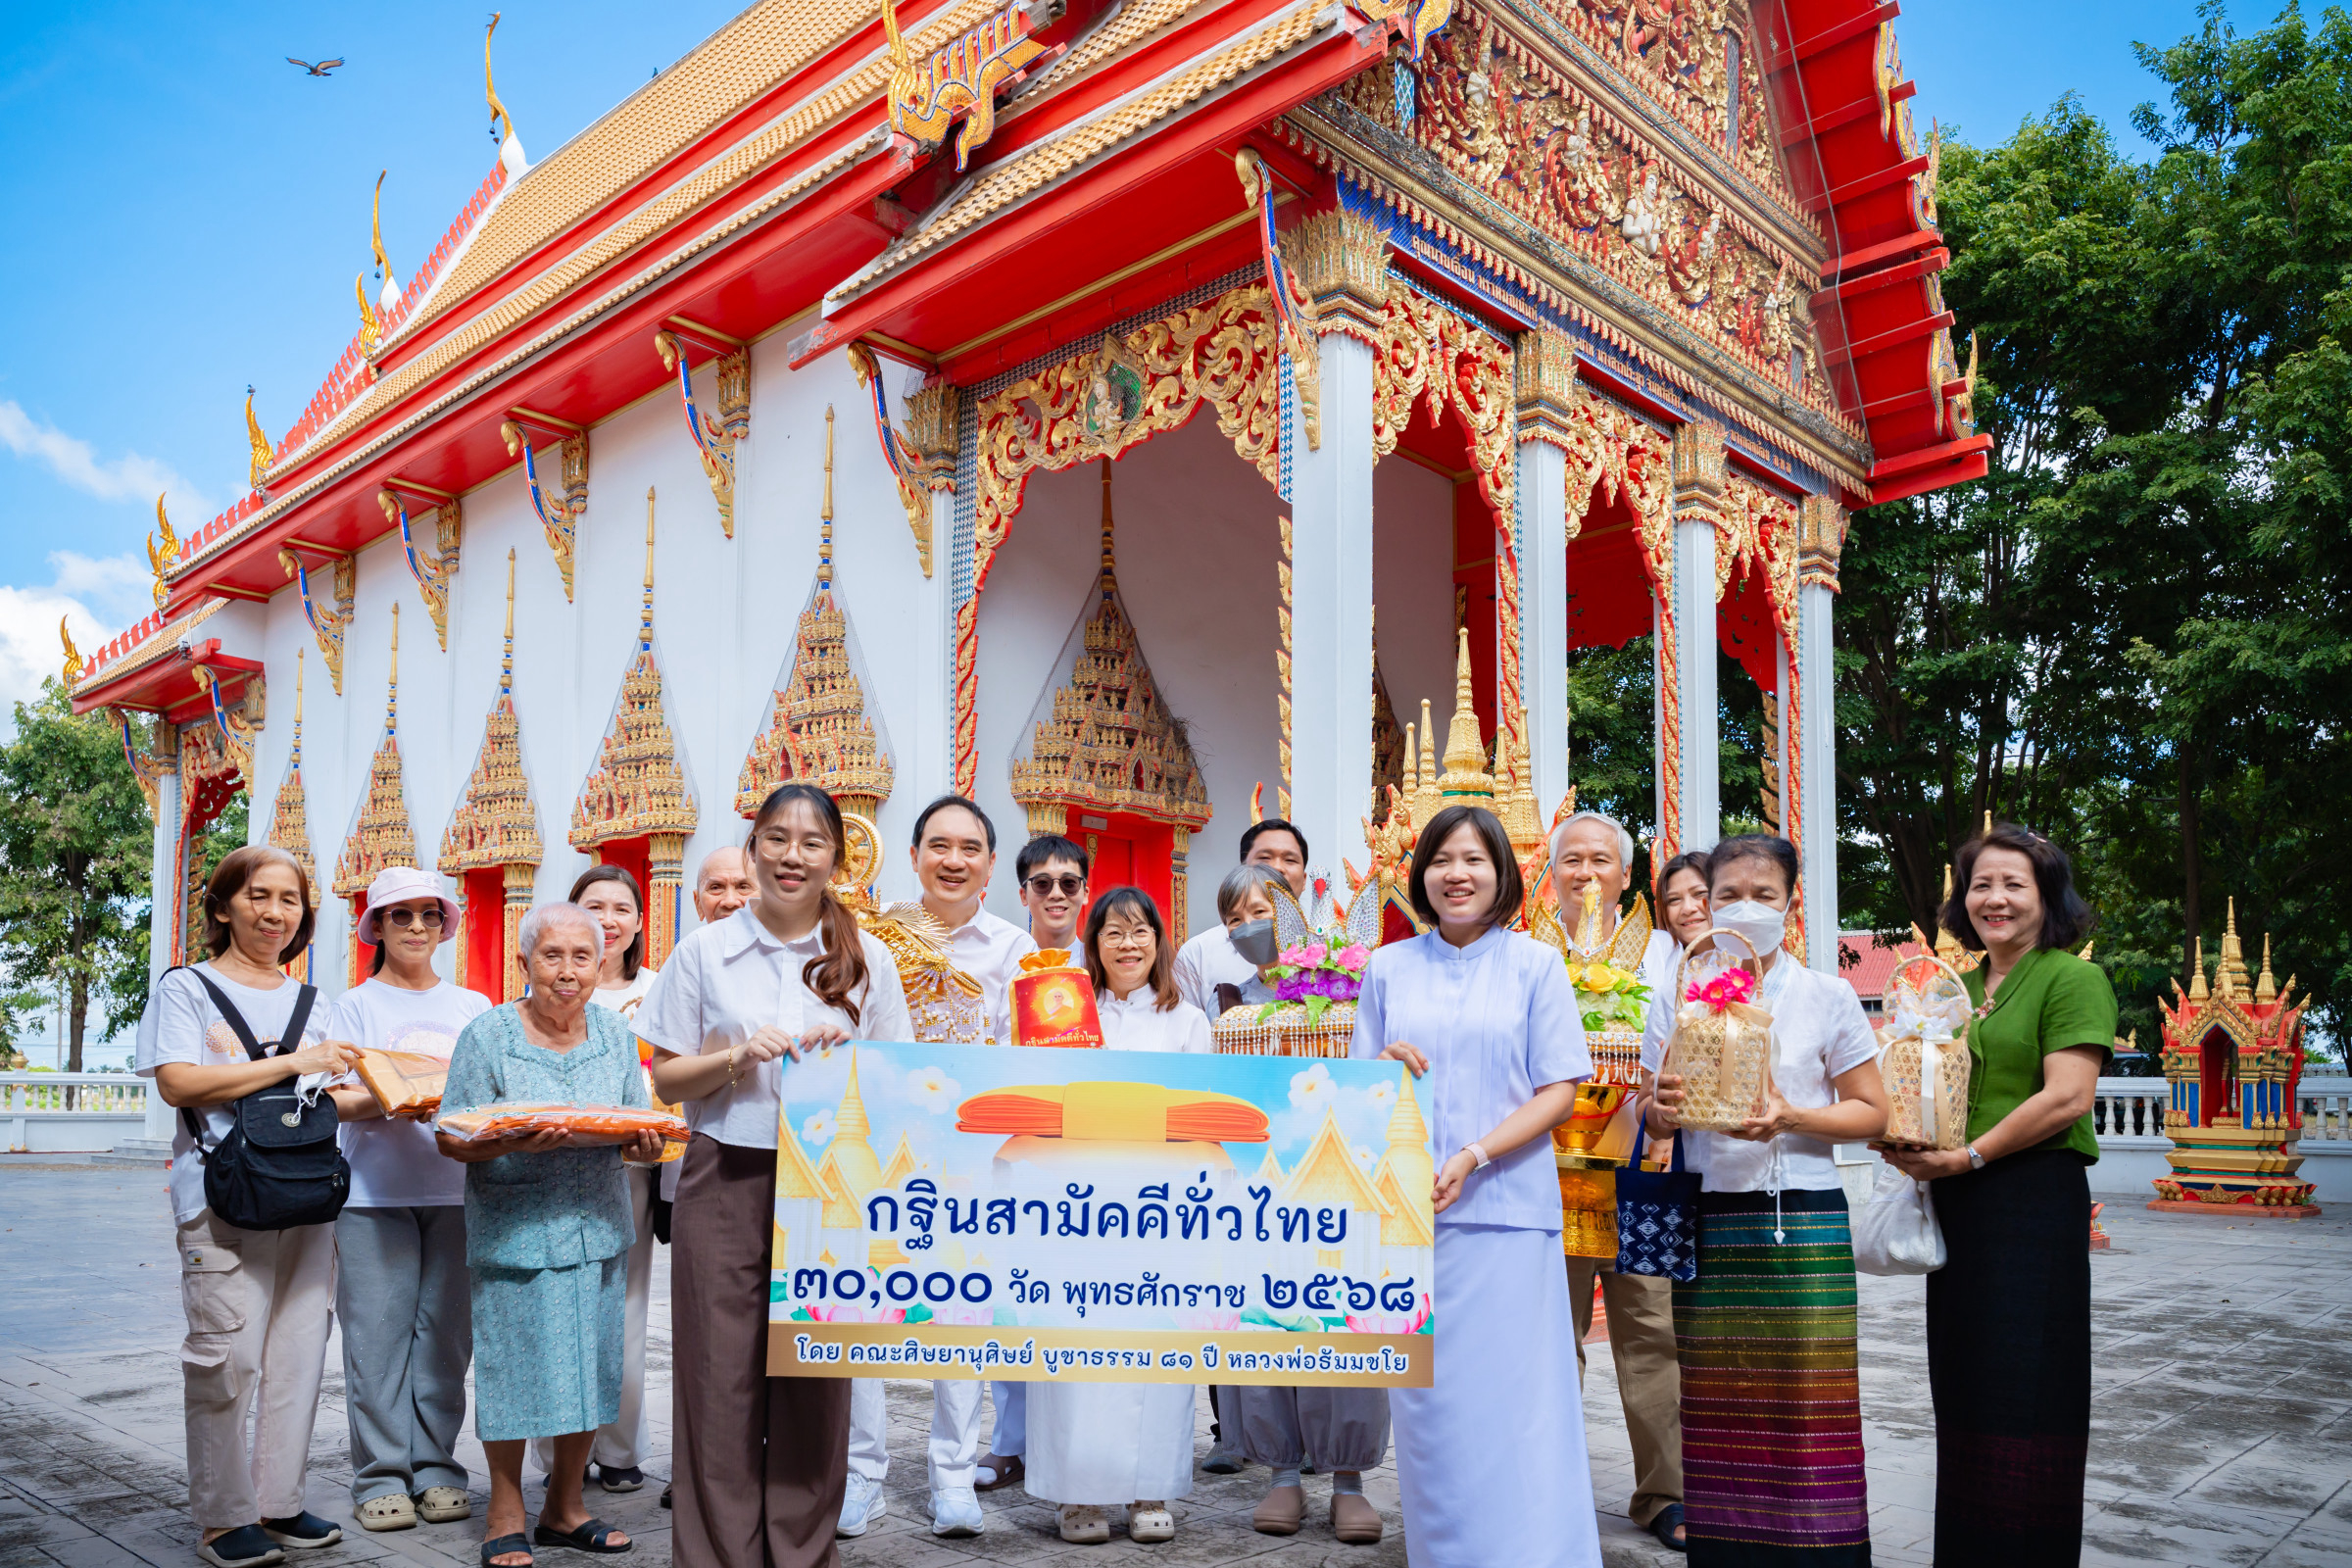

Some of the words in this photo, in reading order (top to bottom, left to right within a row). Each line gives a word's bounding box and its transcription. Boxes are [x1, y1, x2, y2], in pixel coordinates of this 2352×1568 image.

[867, 1170, 1348, 1250] กฐินสามัคคีทั่วไทย
[794, 1268, 993, 1309] ๓๐,๐๐๐
[1008, 1268, 1050, 1304] วัด
[1062, 1271, 1246, 1318] พุทธศักราช
[1261, 1273, 1415, 1312] ๒๕๖๘
[797, 1336, 840, 1361] โดย
[851, 1340, 1033, 1373] คณะศิษยานุศิษย์
[1043, 1348, 1151, 1373] บูชาธรรม
[1161, 1351, 1193, 1369] ๘๑
[1202, 1345, 1217, 1368] ปี
[1228, 1348, 1407, 1372] หลวงพ่อธัมมชโย
